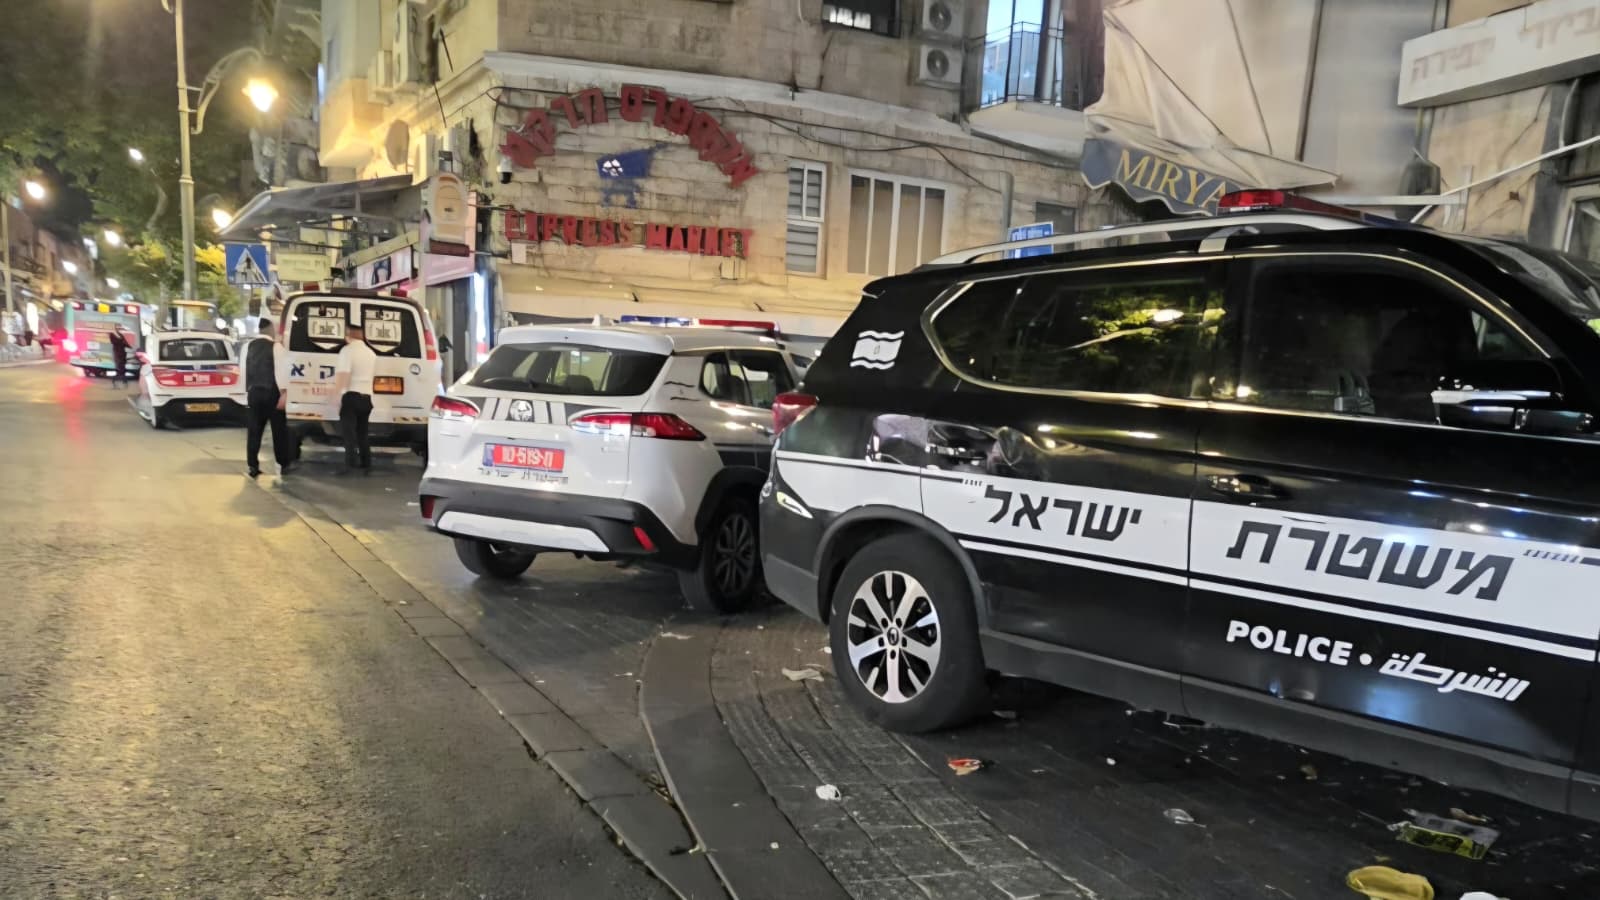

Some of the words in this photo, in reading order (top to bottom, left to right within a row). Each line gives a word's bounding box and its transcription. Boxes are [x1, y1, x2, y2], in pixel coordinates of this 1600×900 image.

[983, 484, 1142, 541] ישראל
[1226, 520, 1515, 601] משטרת
[1226, 619, 1354, 666] POLICE
[1378, 651, 1531, 701] الشرطة
